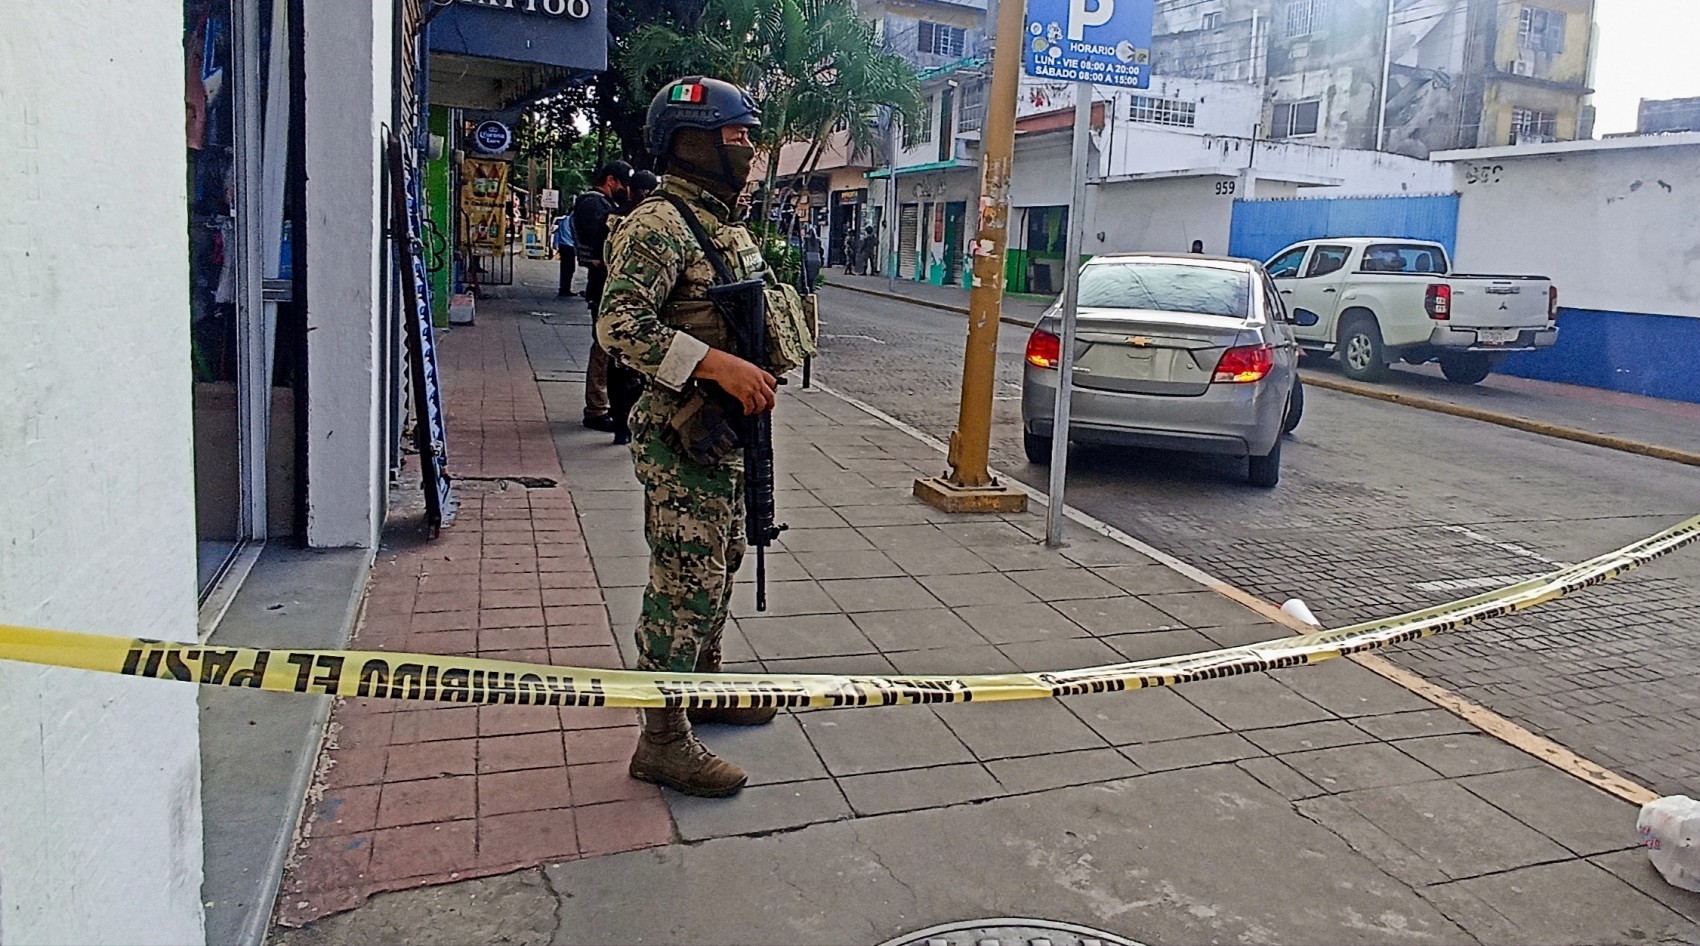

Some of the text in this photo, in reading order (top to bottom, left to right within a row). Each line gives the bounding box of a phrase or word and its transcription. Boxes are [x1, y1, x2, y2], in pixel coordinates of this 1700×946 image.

[1067, 0, 1115, 41] P
[1070, 42, 1115, 56] HORARIO
[1034, 54, 1055, 66] LUN
[1062, 58, 1079, 69] VIE
[1080, 60, 1105, 72] 08:00
[1106, 63, 1114, 73] A
[1115, 64, 1140, 75] 20:00
[1078, 72, 1104, 82] 08:00
[1104, 74, 1113, 83] A
[1114, 75, 1138, 86] 15:00
[1215, 181, 1235, 195] 959
[286, 652, 346, 696] EL
[357, 658, 606, 708] PROHIBIDO
